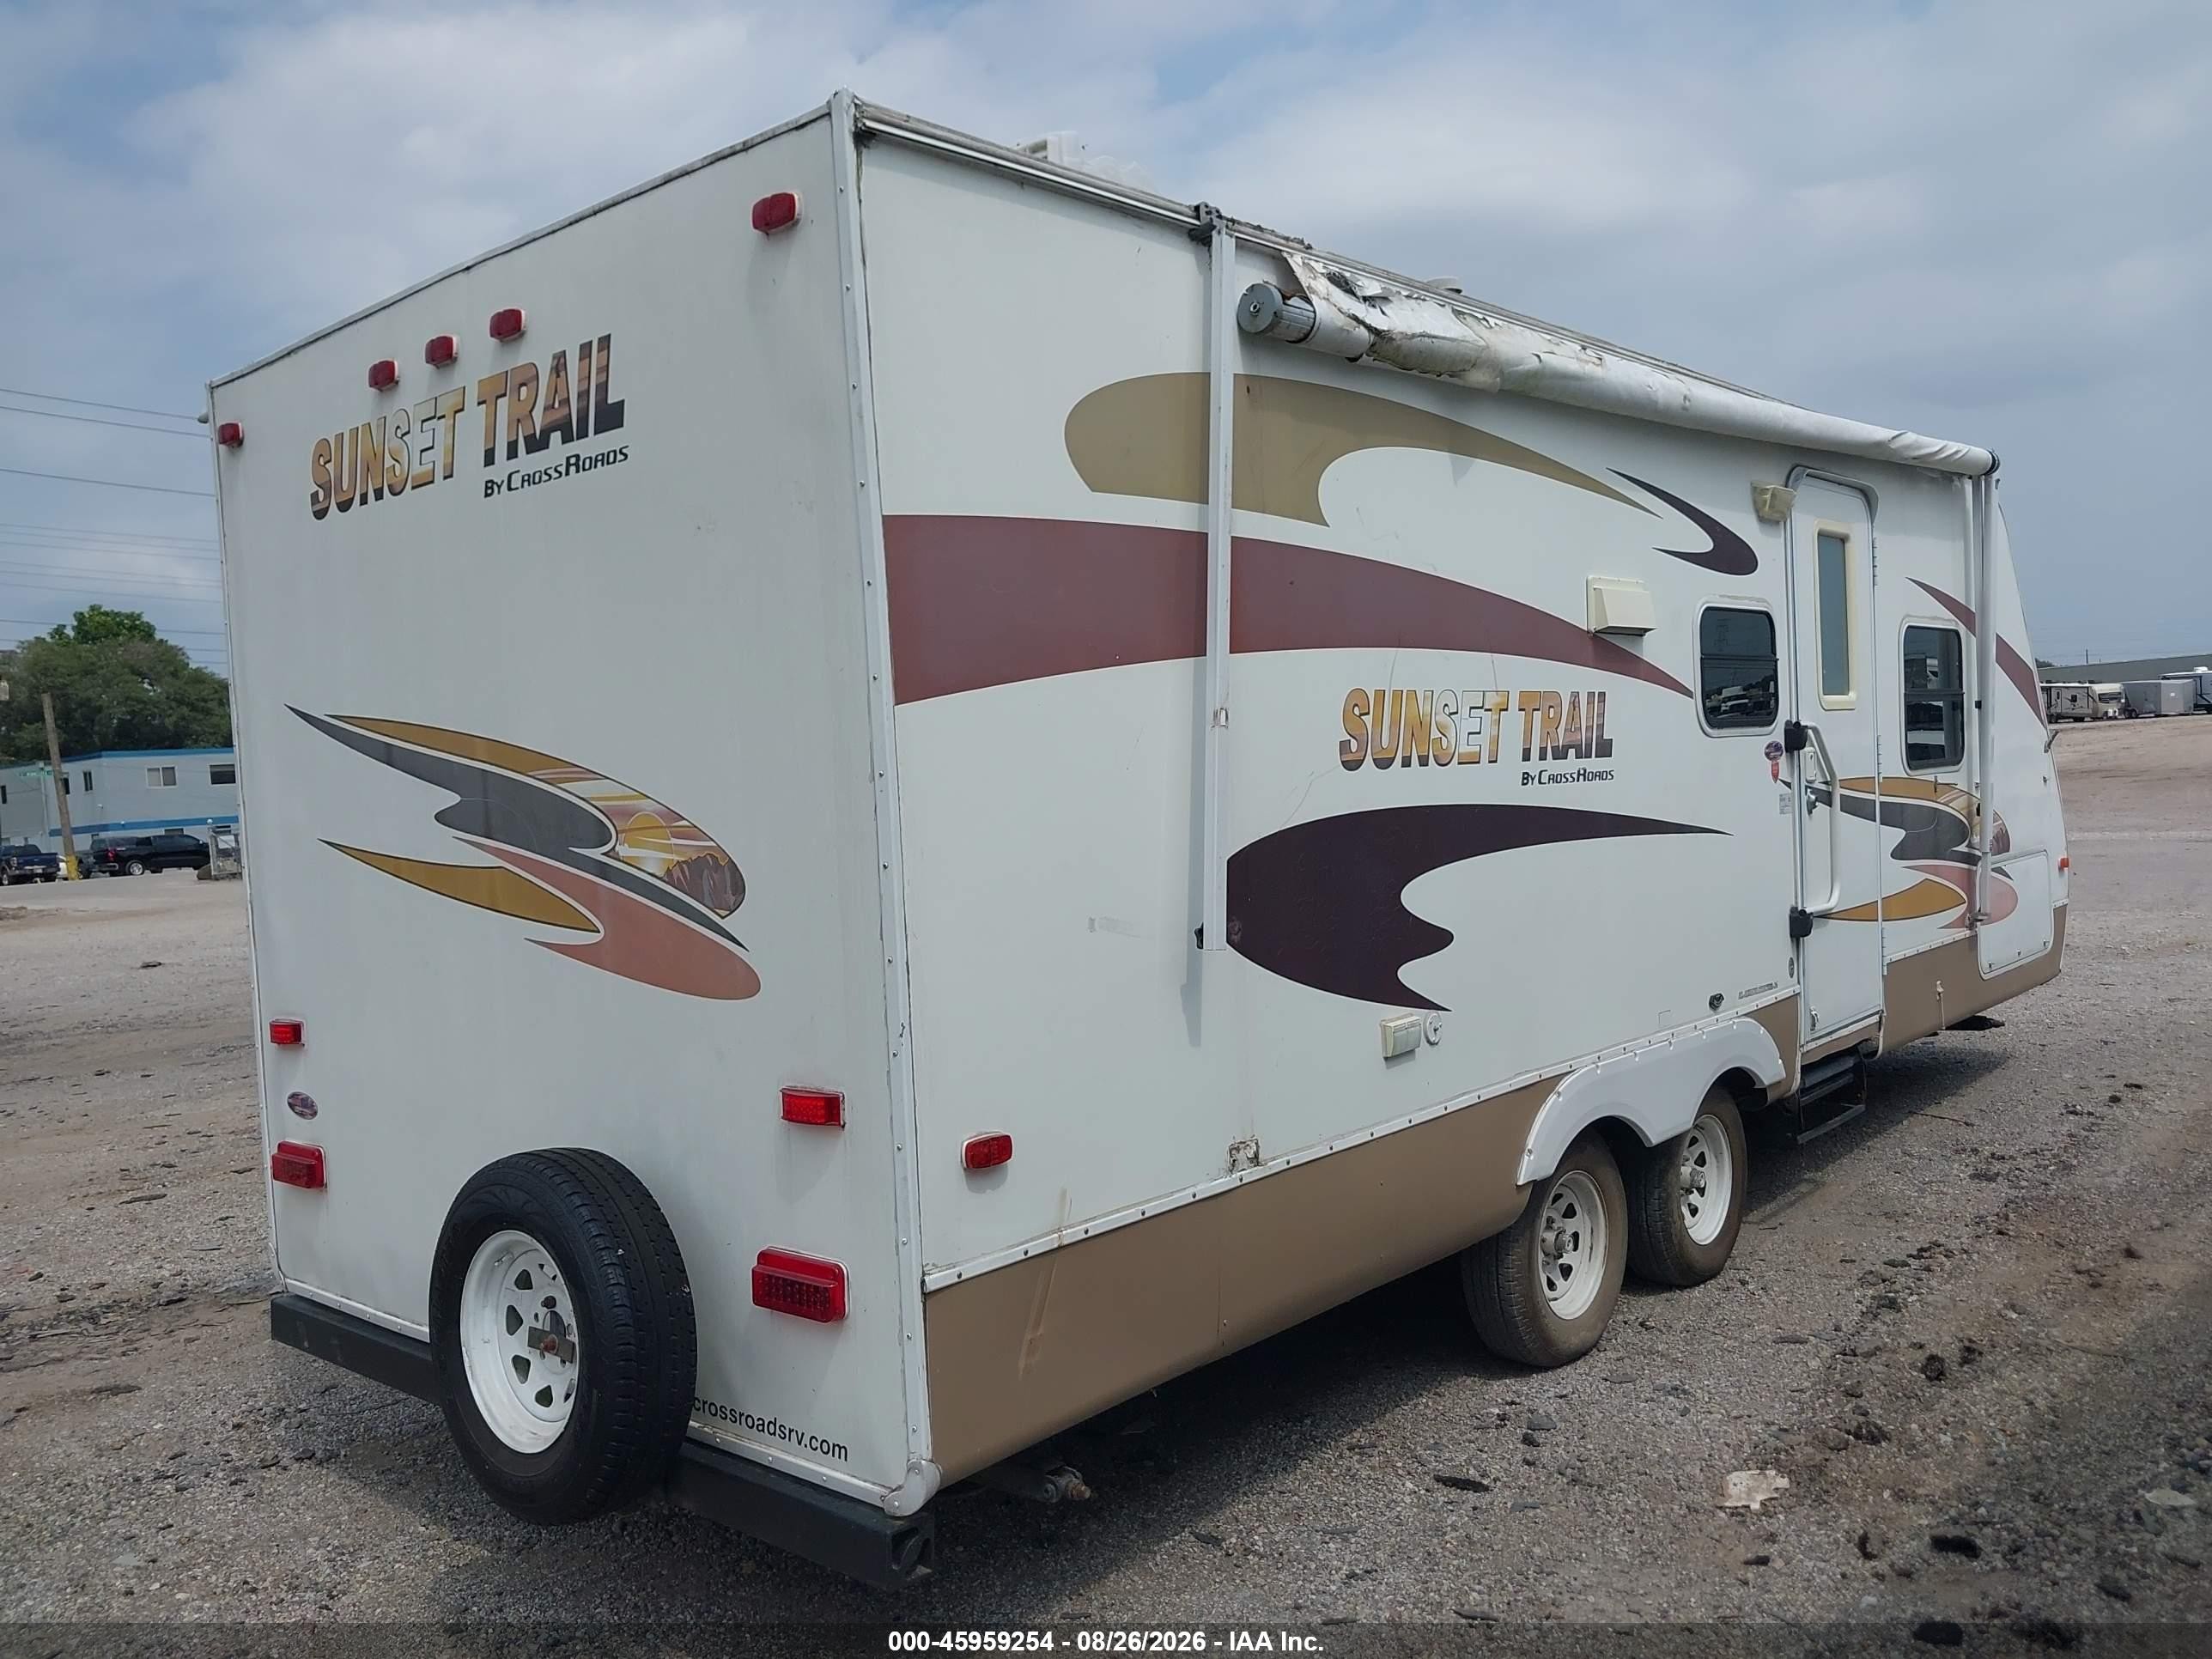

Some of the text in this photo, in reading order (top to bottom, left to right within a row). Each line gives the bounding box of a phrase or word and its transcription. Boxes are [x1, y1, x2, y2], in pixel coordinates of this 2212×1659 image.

[310, 333, 625, 520] SUNSET TRAIL
[1339, 688, 1613, 771] SUNSET TRAIL
[692, 1396, 849, 1462] crossroadsrv.com
